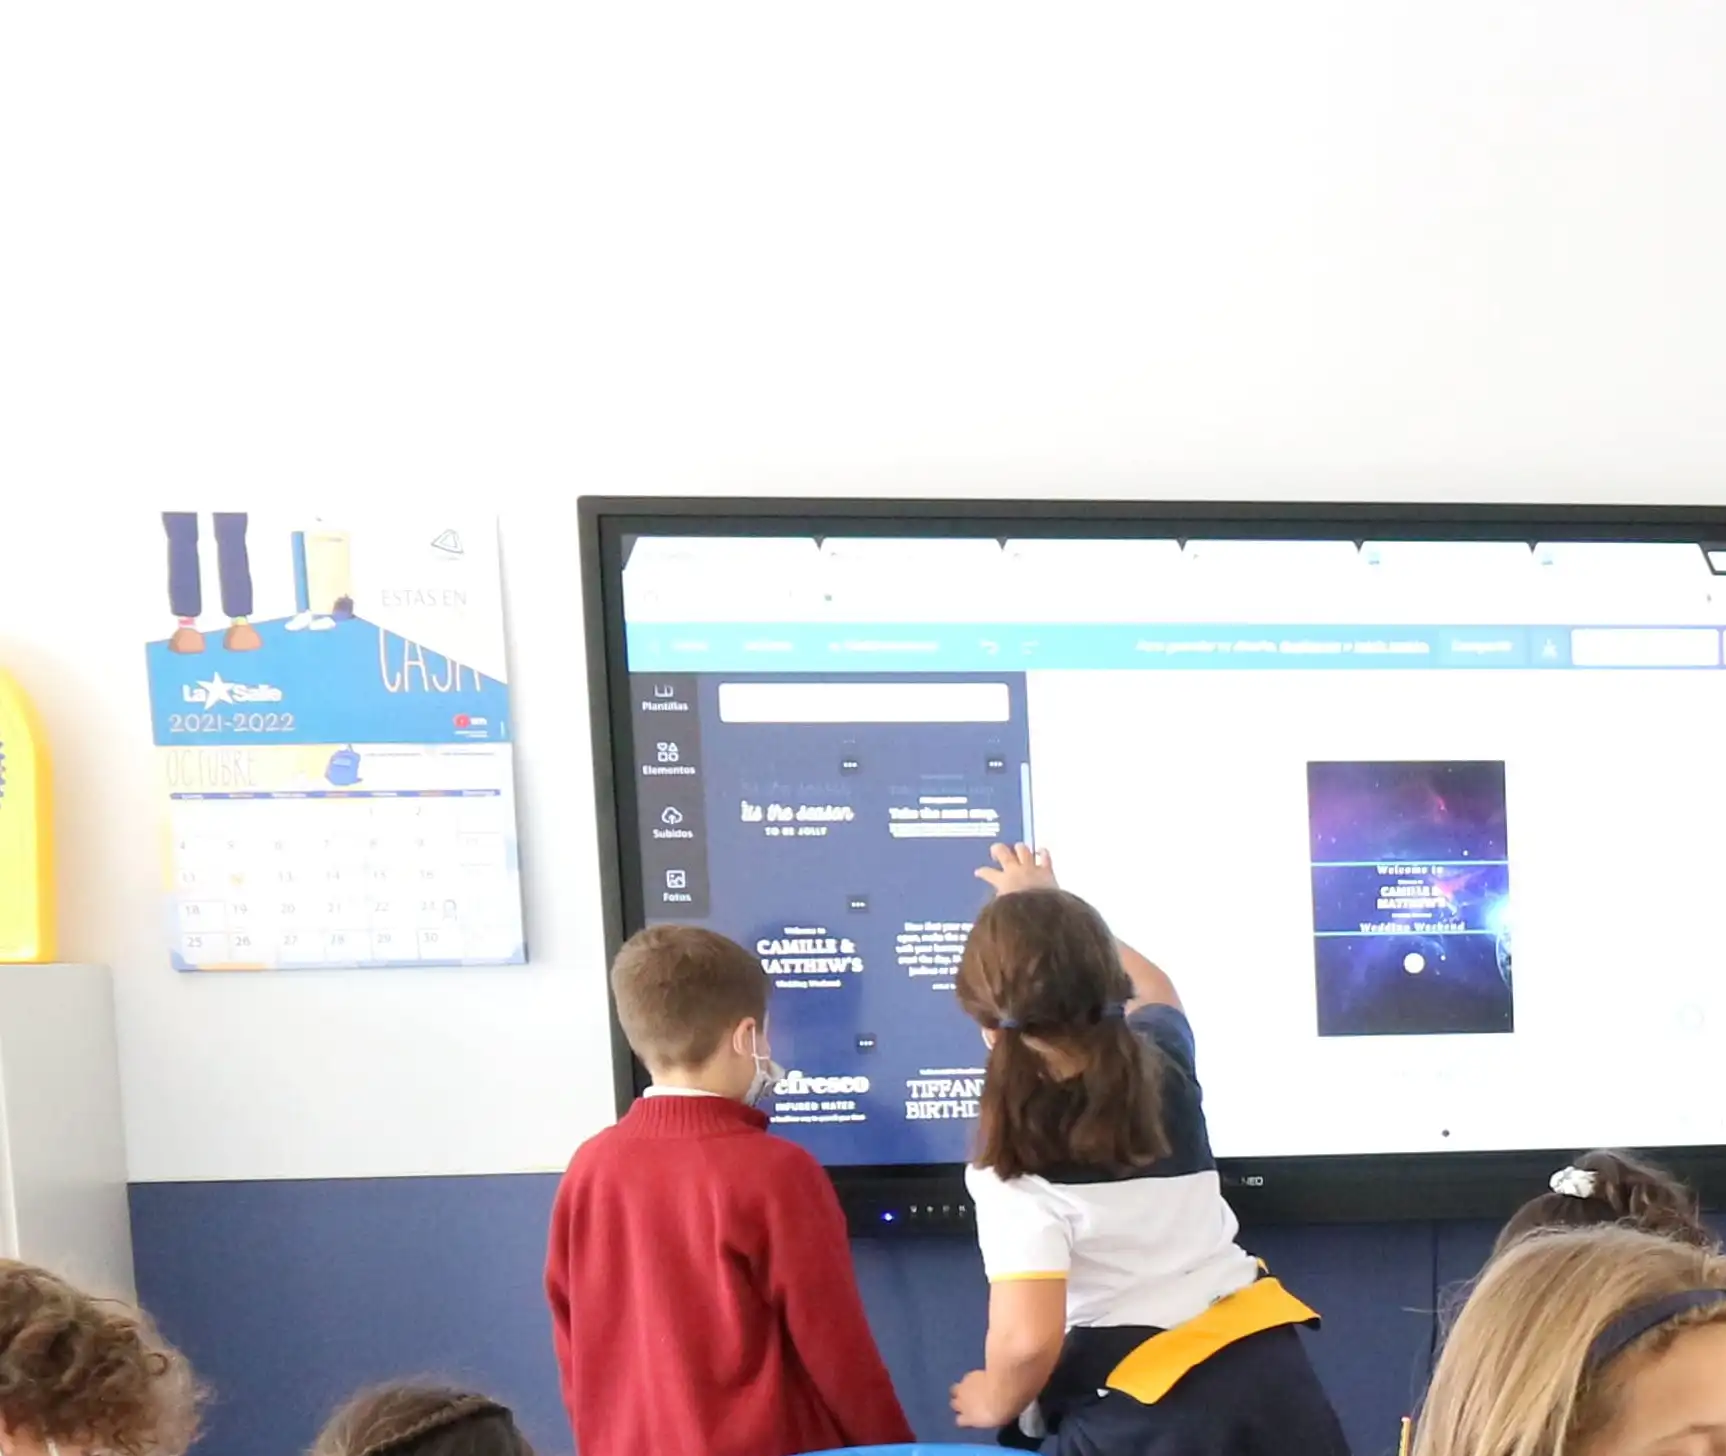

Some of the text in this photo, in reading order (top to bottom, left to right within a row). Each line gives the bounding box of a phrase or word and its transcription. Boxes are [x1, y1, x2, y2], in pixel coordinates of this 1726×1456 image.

[183, 684, 206, 702] La
[642, 701, 689, 711] Plantillas
[170, 712, 295, 732] 2021-2022
[166, 749, 257, 788] OCTUBRE
[642, 765, 695, 775] Elementos
[653, 829, 693, 839] Subidos
[663, 892, 692, 902] Fotos
[186, 936, 203, 948] 25
[234, 936, 251, 947] 26
[757, 939, 838, 954] CAMILLE
[774, 1070, 870, 1094] efresco
[906, 1079, 985, 1098] TIFFAN
